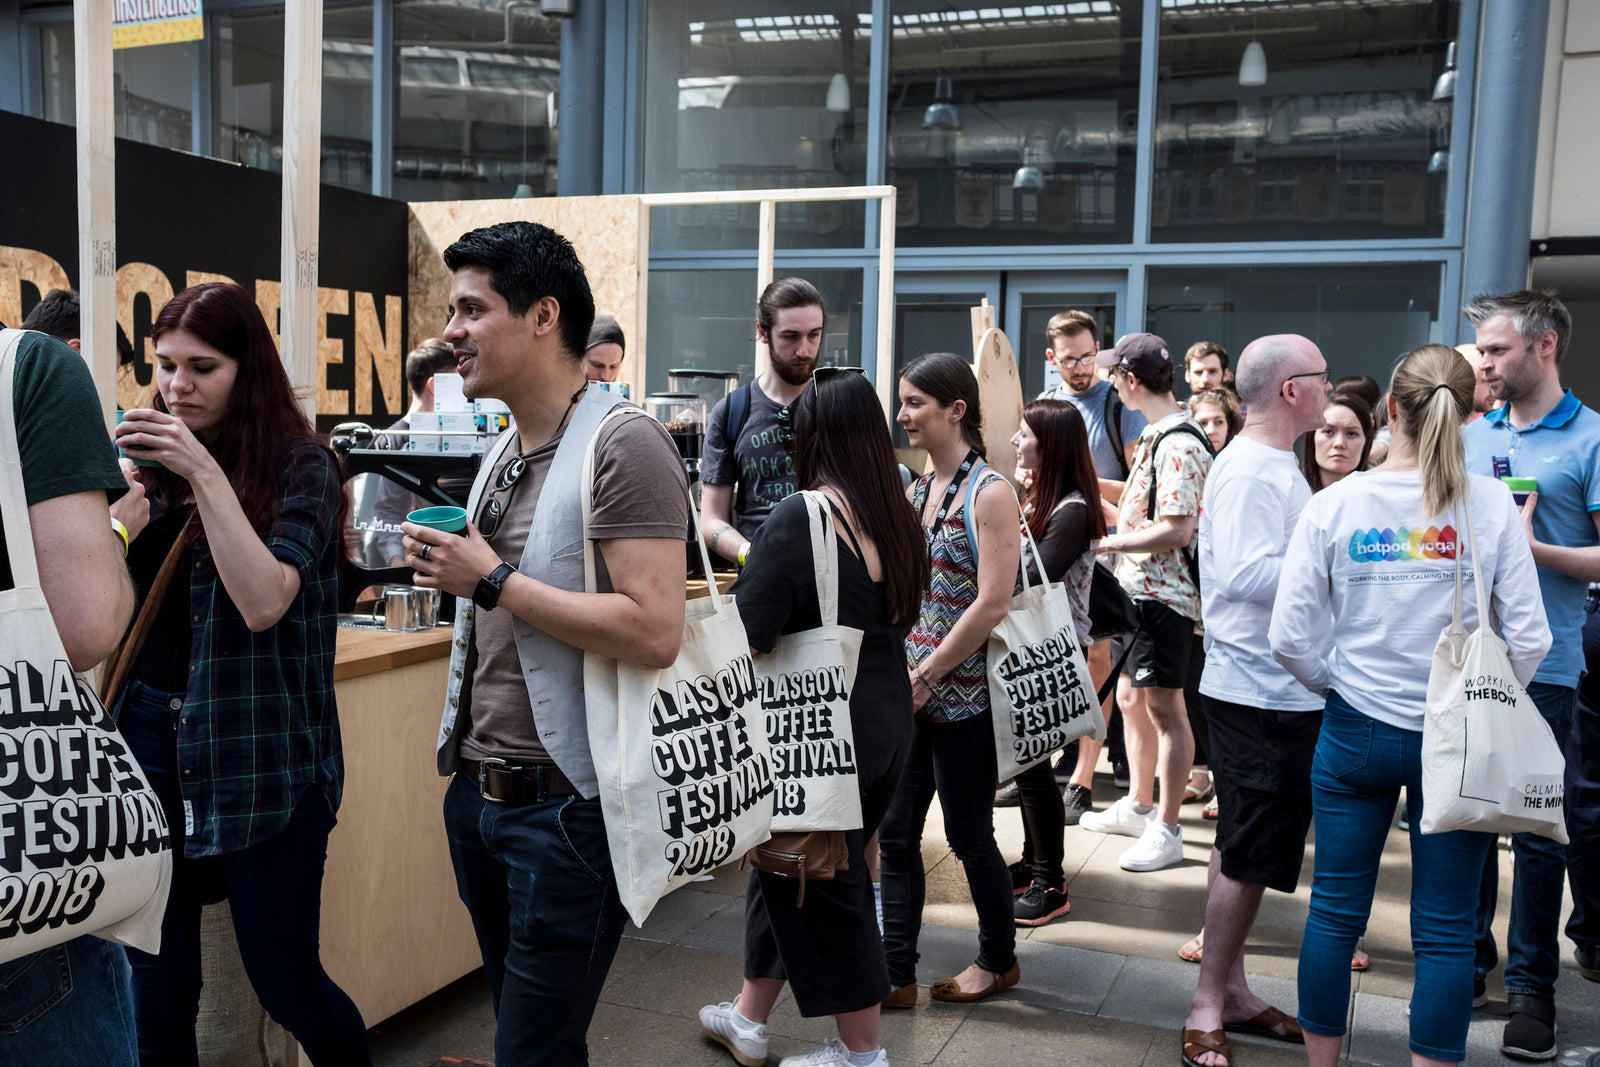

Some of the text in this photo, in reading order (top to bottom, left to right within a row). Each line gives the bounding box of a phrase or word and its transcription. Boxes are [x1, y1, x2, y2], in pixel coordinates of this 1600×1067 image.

[116, 262, 402, 416] GEN
[751, 429, 784, 449] ORIG
[1357, 540, 1456, 556] hotpod yoga
[1348, 575, 1377, 583] WORKING
[1004, 660, 1081, 709] COFFEE
[1465, 675, 1514, 694] WORKIG
[762, 704, 834, 744] OFFEE
[769, 738, 857, 780] STIVAL
[1014, 729, 1066, 765] 2018
[772, 779, 806, 817] 18
[1524, 796, 1564, 808] THE MIN
[1525, 784, 1565, 795] CALMIN
[665, 825, 736, 881] 2018
[0, 865, 105, 940] 2018
